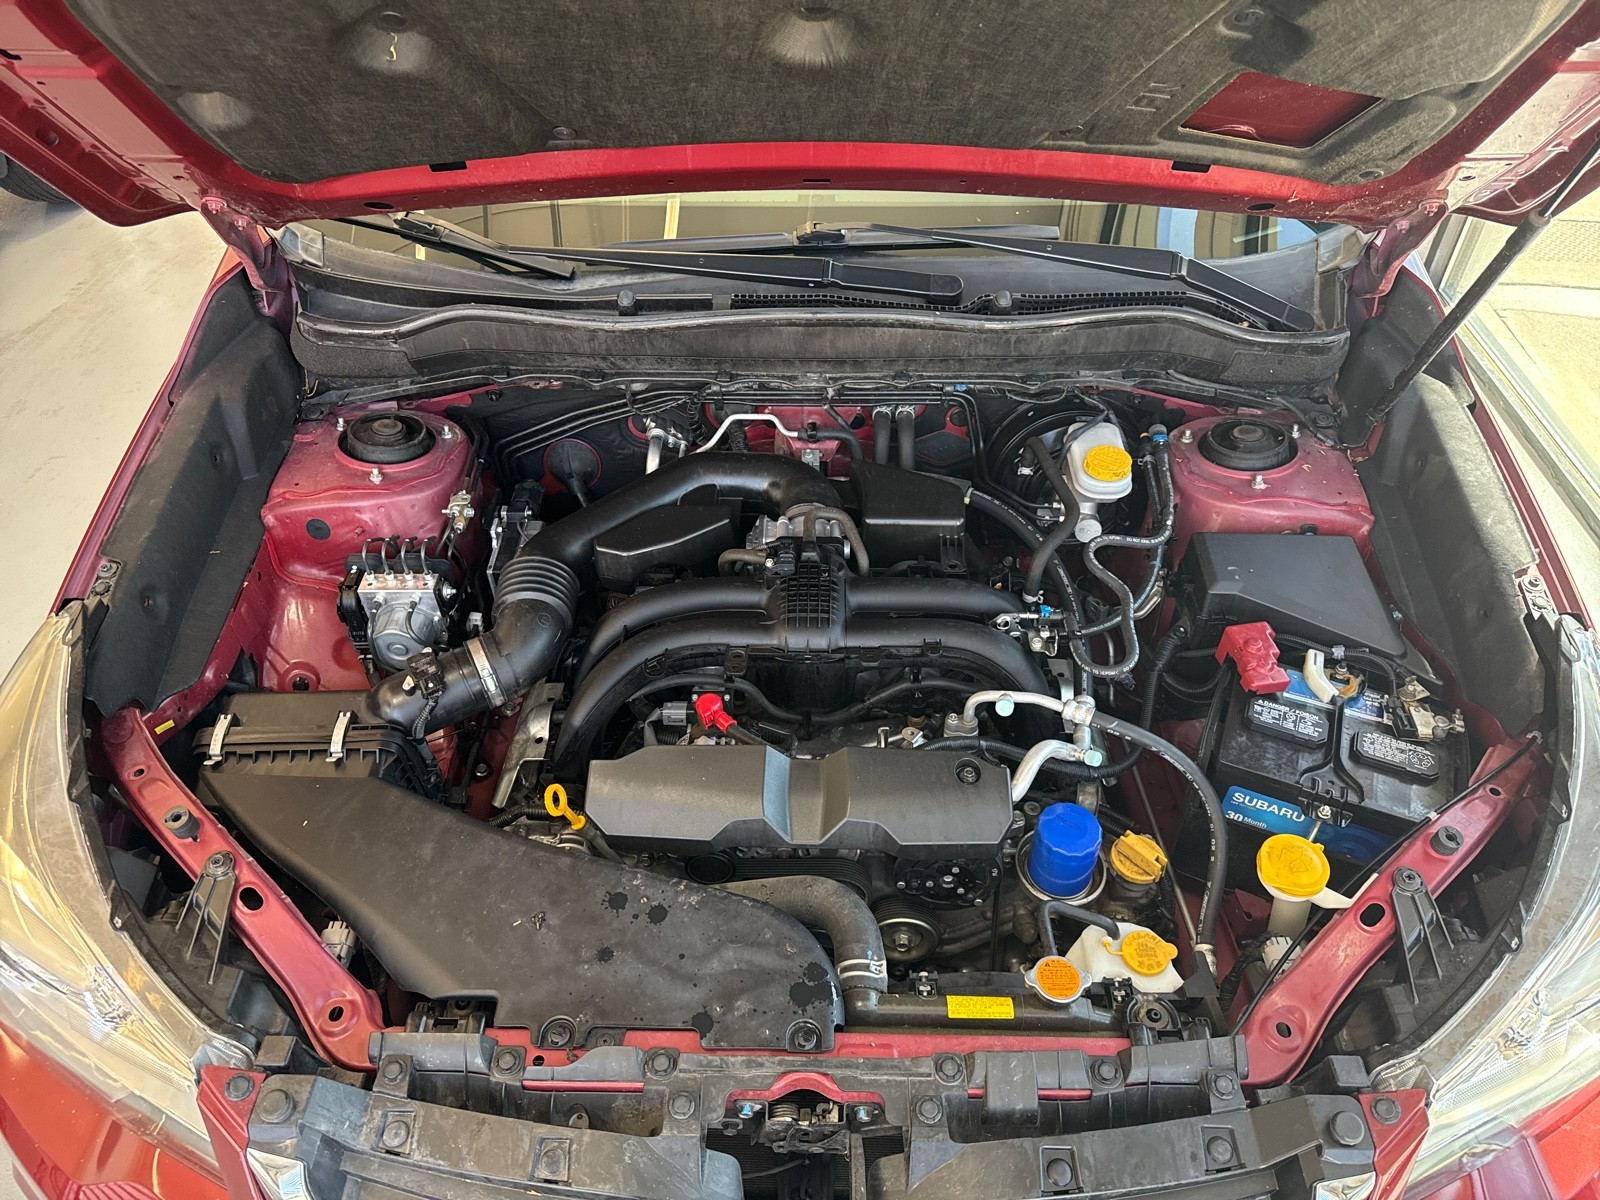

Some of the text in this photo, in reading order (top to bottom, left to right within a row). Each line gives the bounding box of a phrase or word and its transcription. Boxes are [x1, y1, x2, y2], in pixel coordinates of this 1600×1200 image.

[1264, 700, 1290, 713] DANGER
[1296, 709, 1319, 720] POISON
[1232, 792, 1306, 822] SUBARU
[1225, 810, 1267, 830] 30 Month
